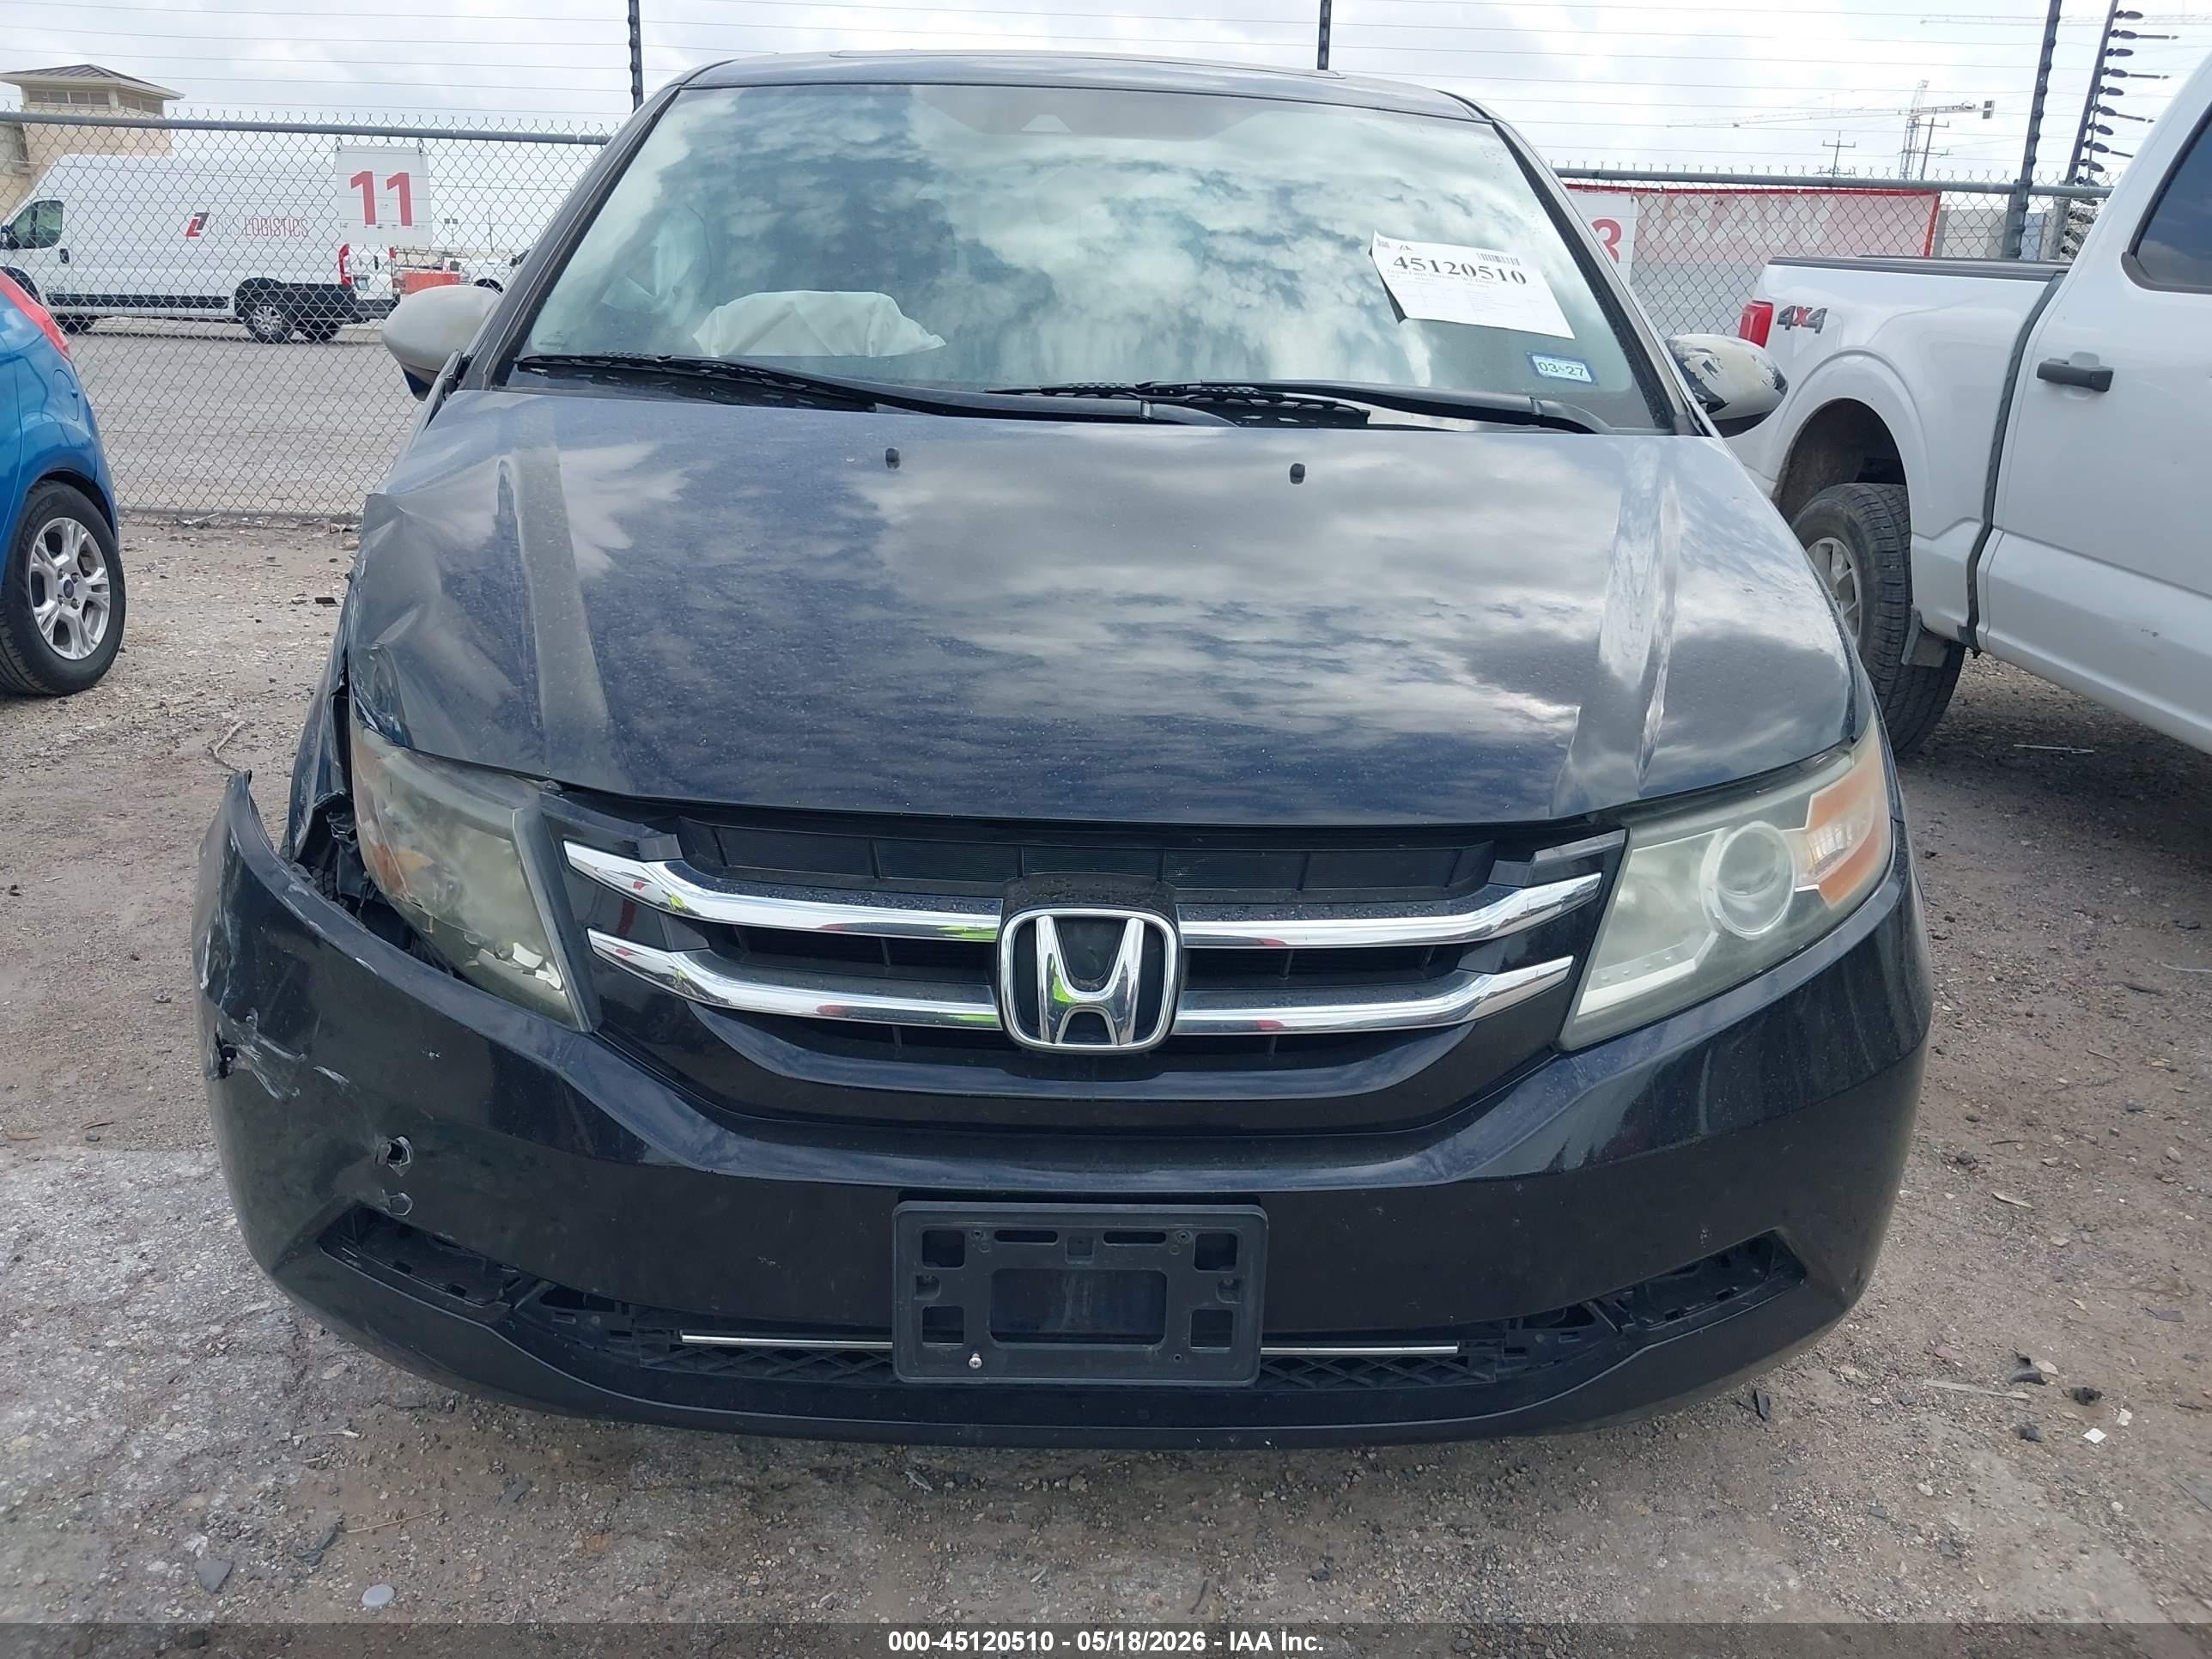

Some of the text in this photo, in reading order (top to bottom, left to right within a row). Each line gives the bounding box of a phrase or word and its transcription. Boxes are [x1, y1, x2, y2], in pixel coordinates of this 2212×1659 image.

[350, 171, 412, 226] 11
[245, 217, 309, 238] LOGISTICS
[1393, 256, 1527, 285] 45120510
